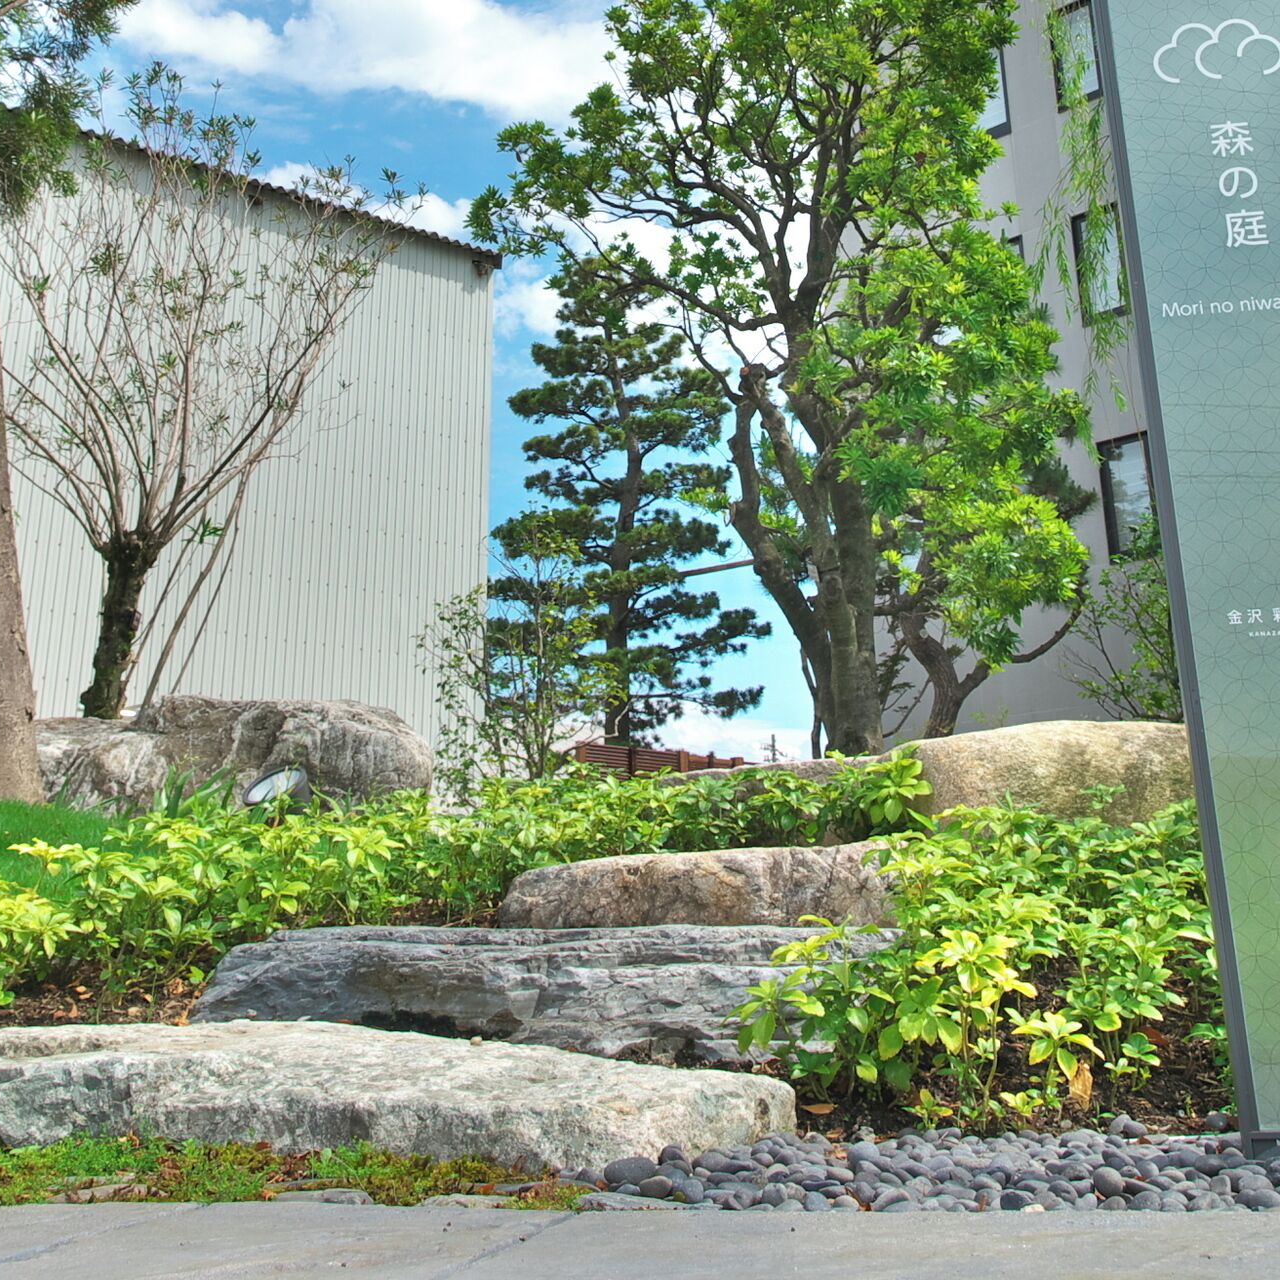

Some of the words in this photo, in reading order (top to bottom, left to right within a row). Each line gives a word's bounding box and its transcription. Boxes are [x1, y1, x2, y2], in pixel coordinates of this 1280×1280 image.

[1210, 120, 1269, 247] 森の庭
[1162, 301, 1204, 317] Mori
[1210, 301, 1234, 314] no
